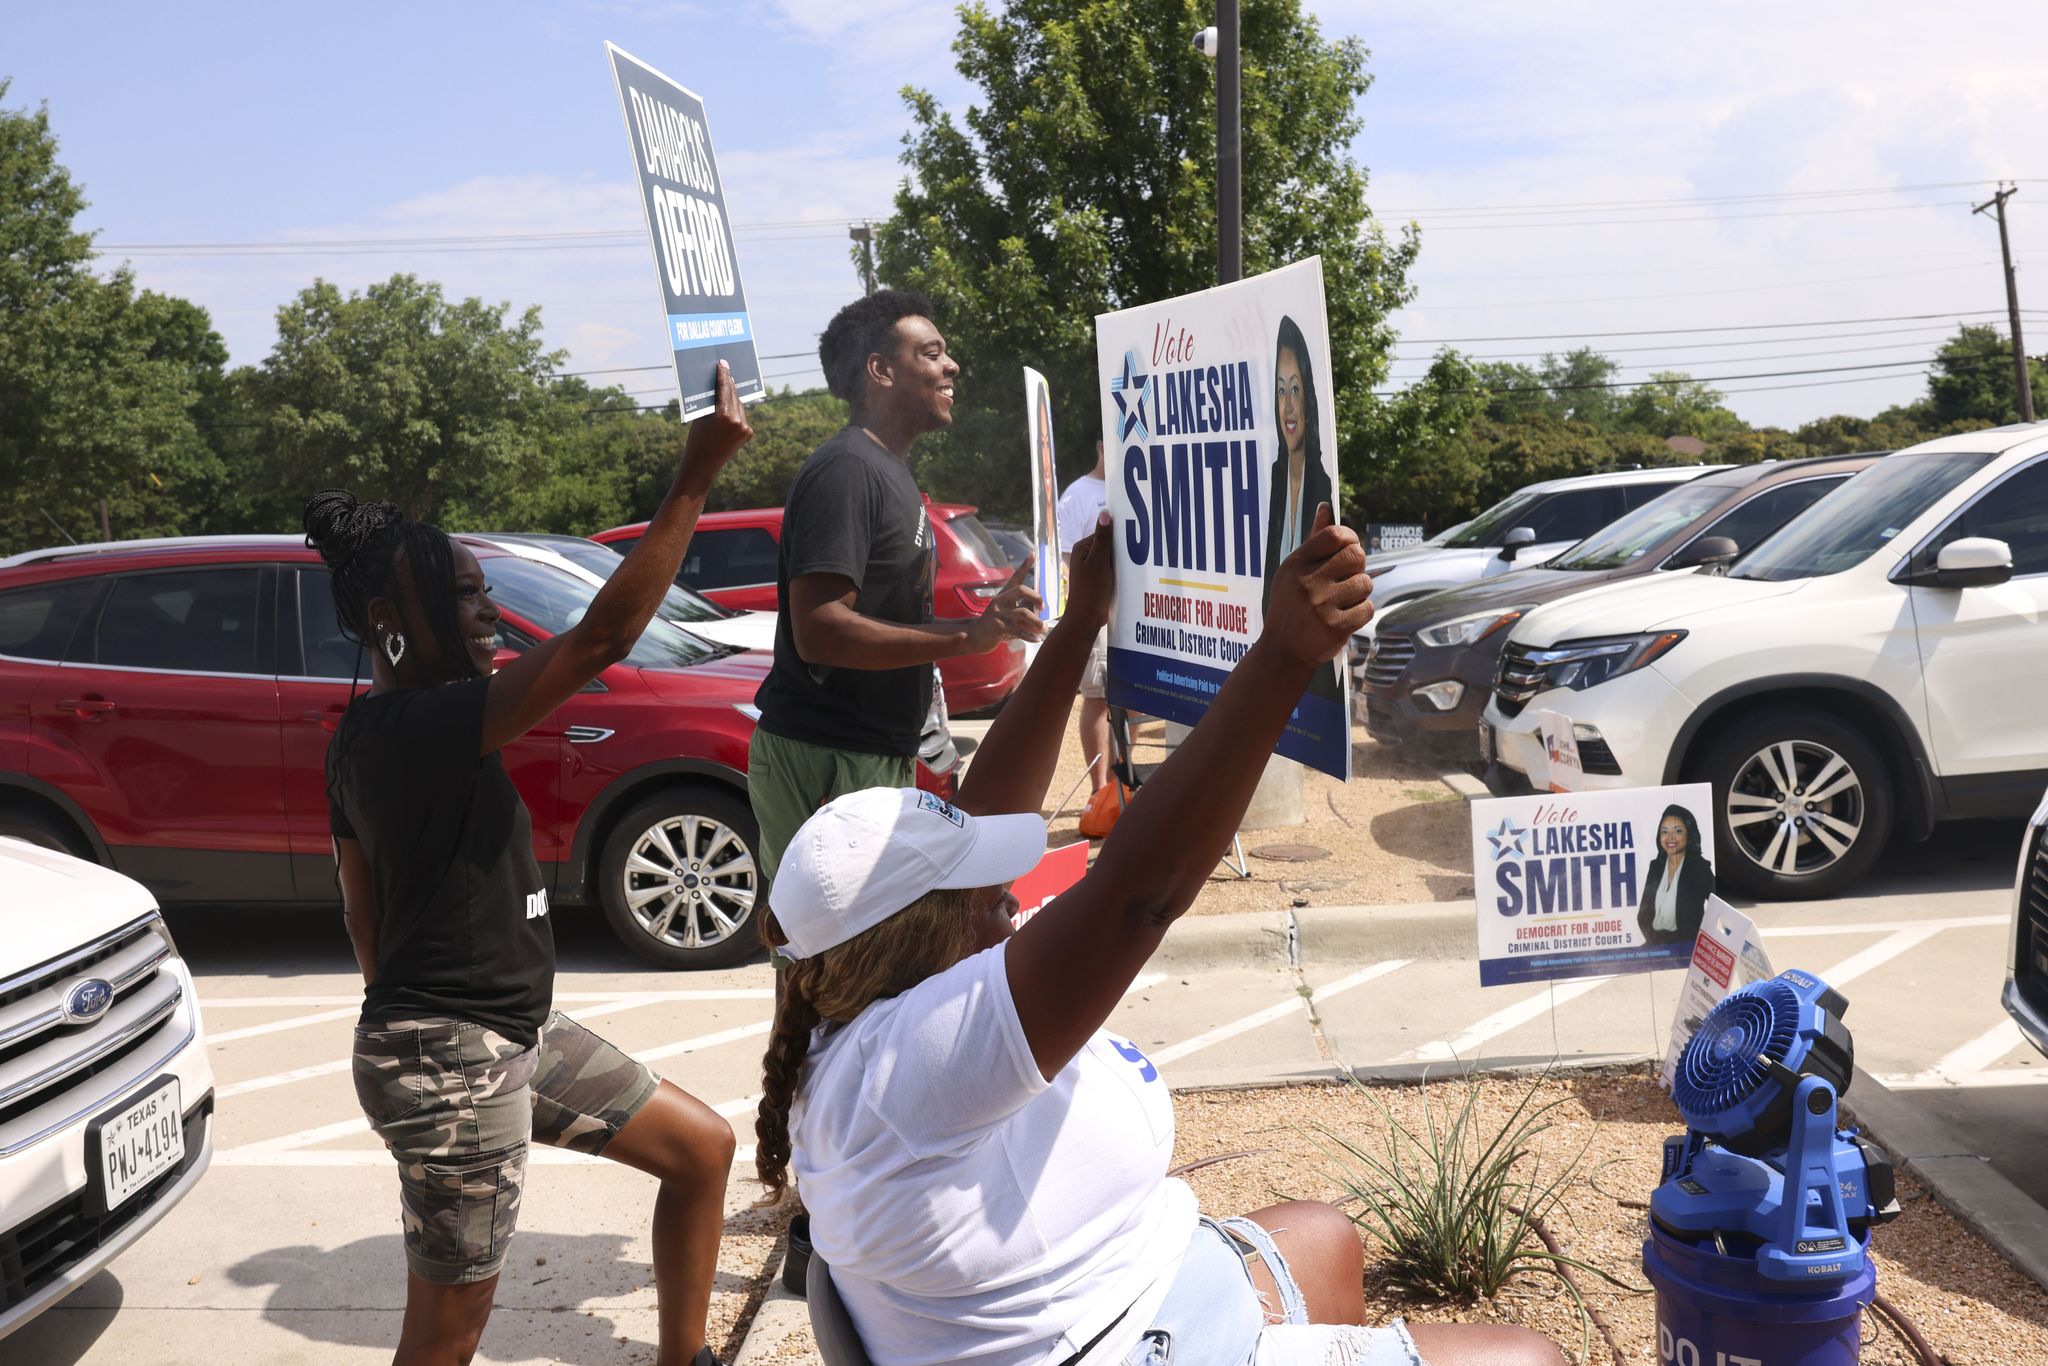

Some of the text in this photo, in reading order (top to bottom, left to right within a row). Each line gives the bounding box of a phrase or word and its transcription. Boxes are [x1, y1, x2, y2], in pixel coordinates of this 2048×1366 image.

[629, 85, 715, 195] DAMARCUS
[653, 184, 735, 297] OFFORD
[676, 318, 744, 341] FOR DALLAS COUNTY CLERK
[1152, 318, 1194, 367] Vote
[1153, 361, 1255, 436] LAKESHA
[1123, 440, 1262, 578] SMITH
[1381, 526, 1424, 537] DAMARCUS
[1144, 592, 1248, 634] DEMOCRAT FOR JUDGE
[1136, 621, 1176, 650] CRIMINAL
[1179, 629, 1217, 659] DISTRICT
[1156, 669, 1173, 684] Political
[1174, 673, 1198, 691] Advertising
[1199, 679, 1208, 693] Paid
[1533, 804, 1579, 826] Vote
[1532, 821, 1634, 856] LAKESHA
[1496, 852, 1637, 917] SMITH
[1508, 933, 1632, 953] CRIMINAL DISTRICT COURT 5
[1516, 920, 1623, 940] DEMOCRAT FOR JUDGE
[1782, 971, 1815, 989] KOBALT
[82, 987, 107, 1011] Ford
[127, 1100, 157, 1130] TEXAS
[129, 1181, 137, 1189] The
[138, 1175, 147, 1185] Lone
[155, 1161, 166, 1171] State
[1808, 1263, 1841, 1274] KOBALT
[1660, 1321, 1699, 1366] DO
